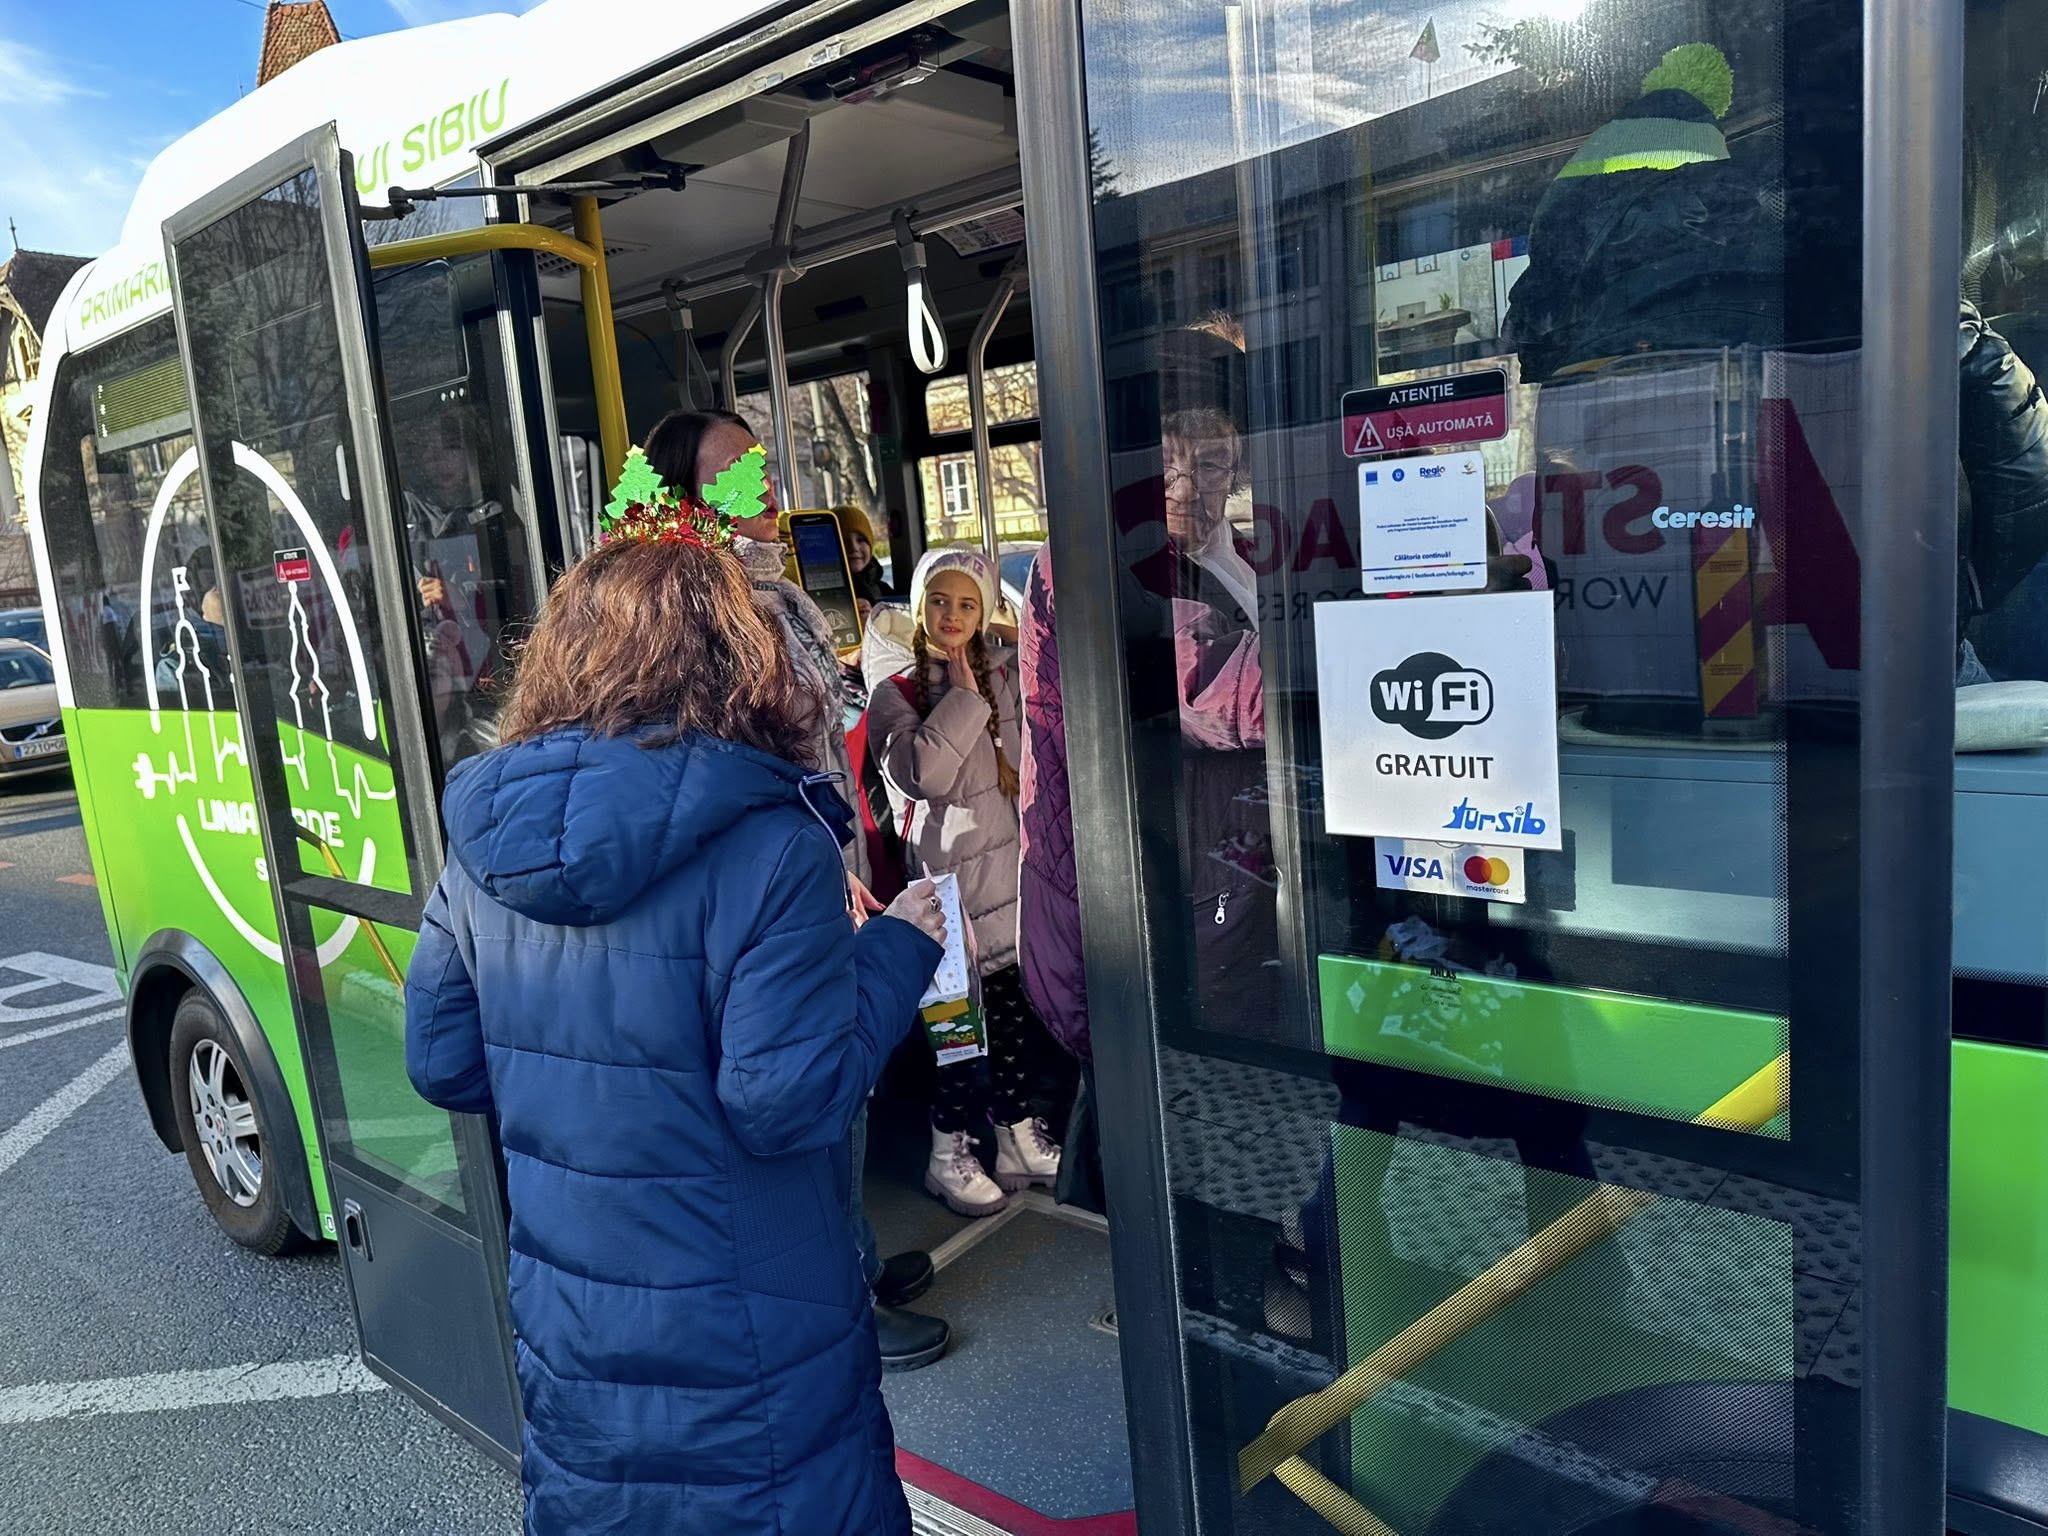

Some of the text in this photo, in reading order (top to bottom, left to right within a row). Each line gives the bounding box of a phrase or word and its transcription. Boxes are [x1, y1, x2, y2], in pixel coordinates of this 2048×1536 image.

[402, 78, 510, 172] SIBIU
[1388, 382, 1454, 404] ATENȚIE
[1416, 411, 1494, 435] AUTOMATĂ
[1419, 465, 1447, 476] Regio
[1651, 504, 1755, 529] Ceresit
[1375, 753, 1494, 779] GRATUIT
[197, 797, 259, 836] LINIA
[1383, 854, 1444, 880] VISA
[1465, 884, 1509, 896] mastercard
